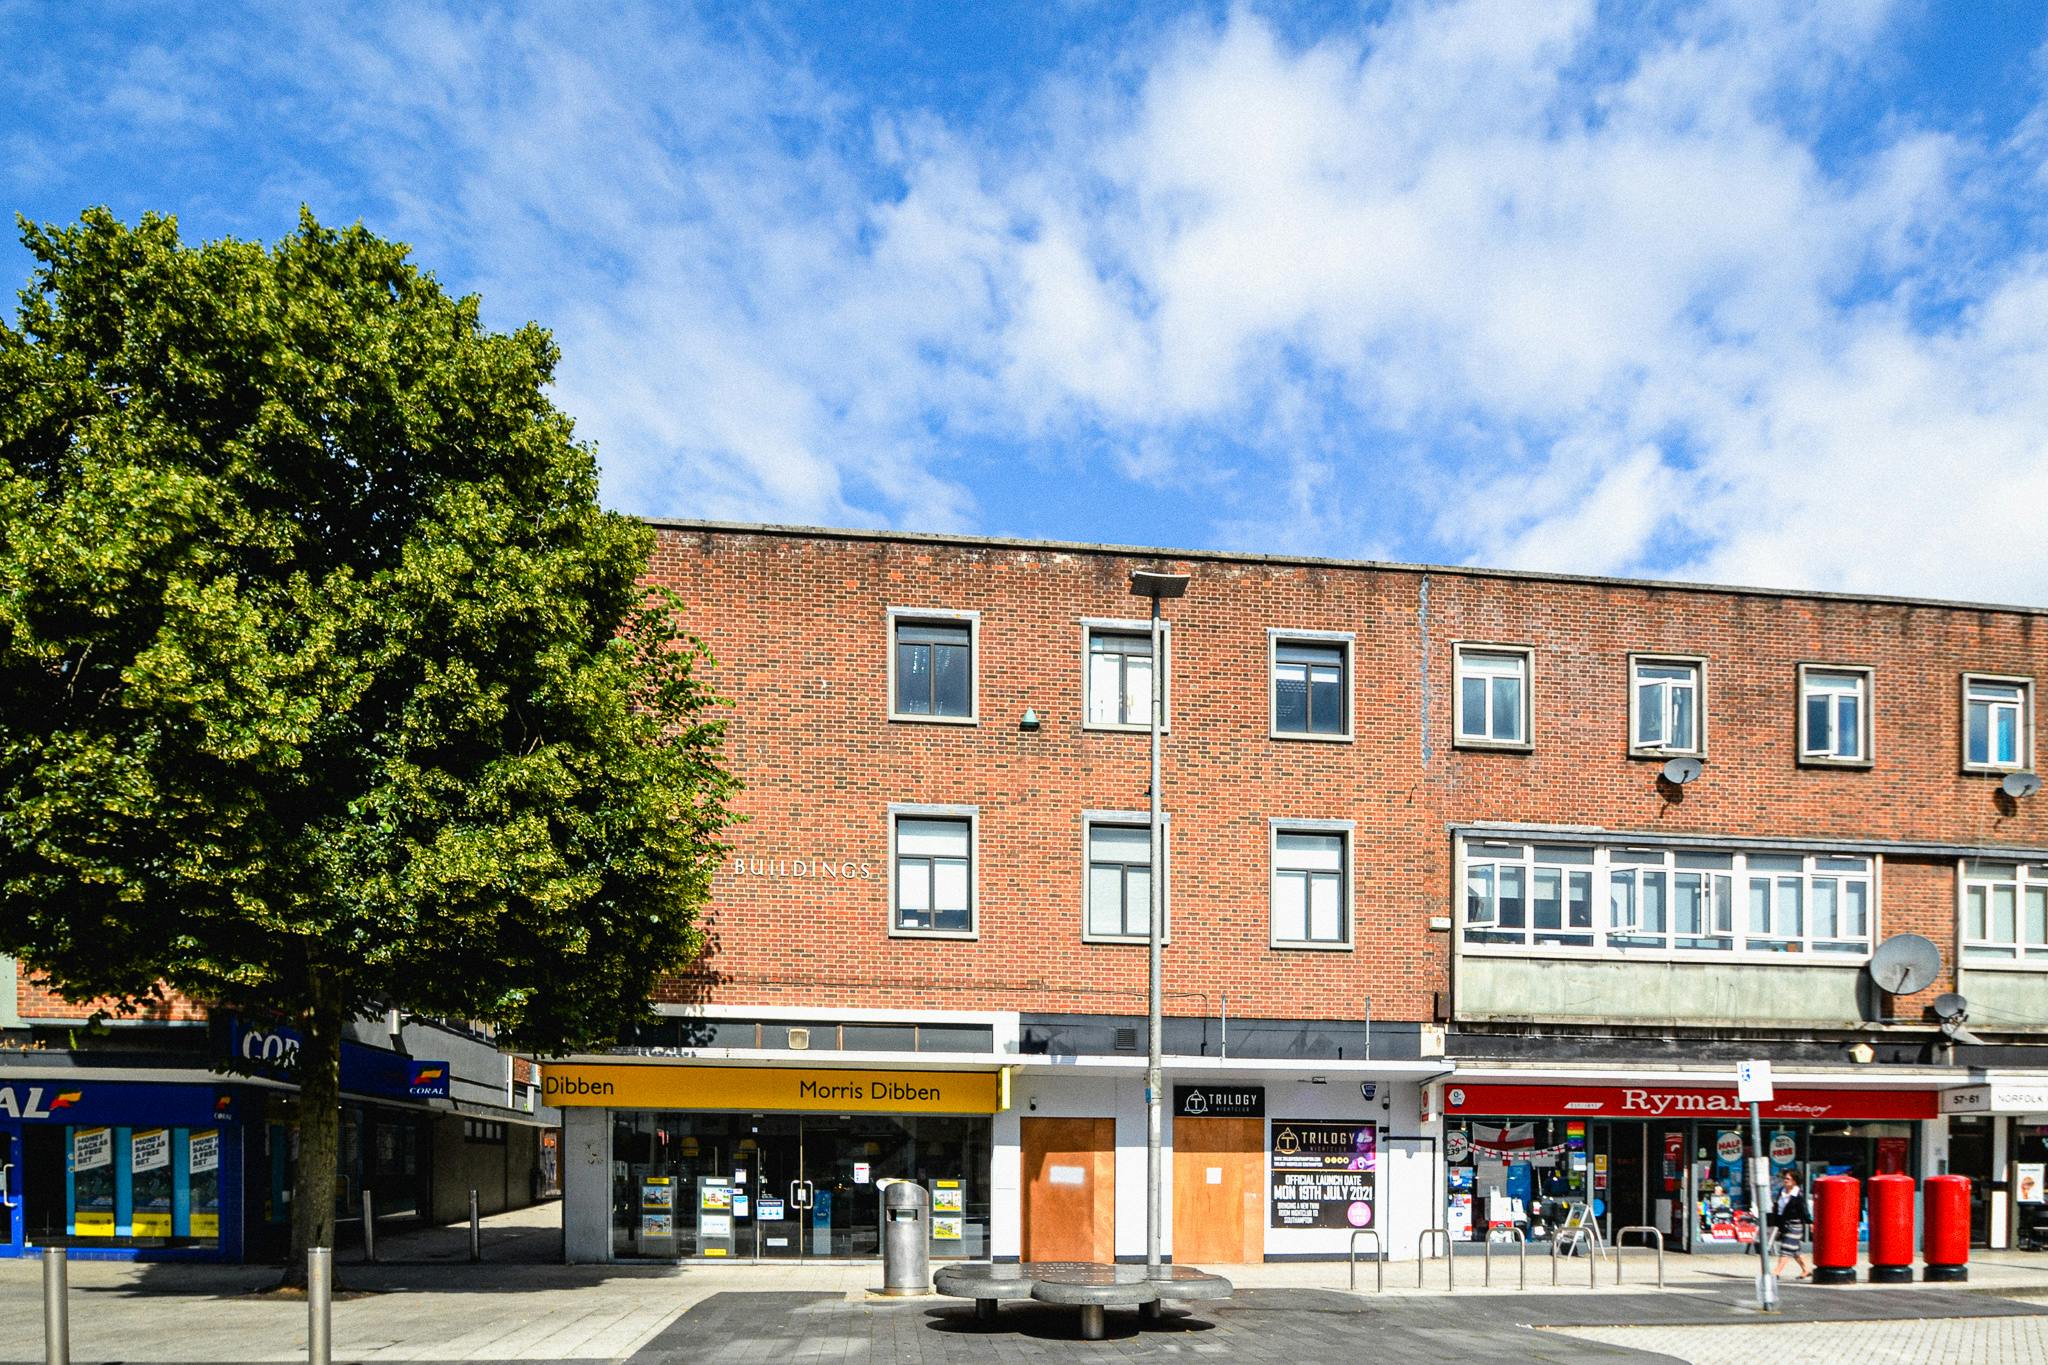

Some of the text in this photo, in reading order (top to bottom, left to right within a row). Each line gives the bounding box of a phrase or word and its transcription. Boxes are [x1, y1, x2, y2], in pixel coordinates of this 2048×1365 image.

[734, 858, 871, 880] BUILDINGS
[409, 1087, 444, 1095] CORAL
[545, 1076, 614, 1096] Dibben
[799, 1081, 941, 1102] Morris Dibben
[1208, 1093, 1257, 1106] TRILOGY
[1953, 1095, 1979, 1105] 57-61
[1997, 1094, 2044, 1104] NORFOLK
[77, 1133, 103, 1145] MONEY
[135, 1135, 161, 1146] MONEY
[1301, 1131, 1355, 1145] TRILOGY
[77, 1139, 108, 1152] BACK AS
[135, 1141, 166, 1153] BACK AS
[192, 1144, 213, 1154] BACK
[1718, 1140, 1740, 1150] HALF
[84, 1148, 103, 1157] FREE
[142, 1149, 160, 1158] FREE
[199, 1150, 217, 1159] FREE
[1773, 1147, 1793, 1156] FREE
[77, 1156, 93, 1165] BET
[135, 1158, 150, 1166] BET
[192, 1159, 208, 1167] BET
[1285, 1174, 1362, 1186] OFFICIAL LAUNCH DATE
[1273, 1185, 1373, 1201] MON 19TH JULY 2021
